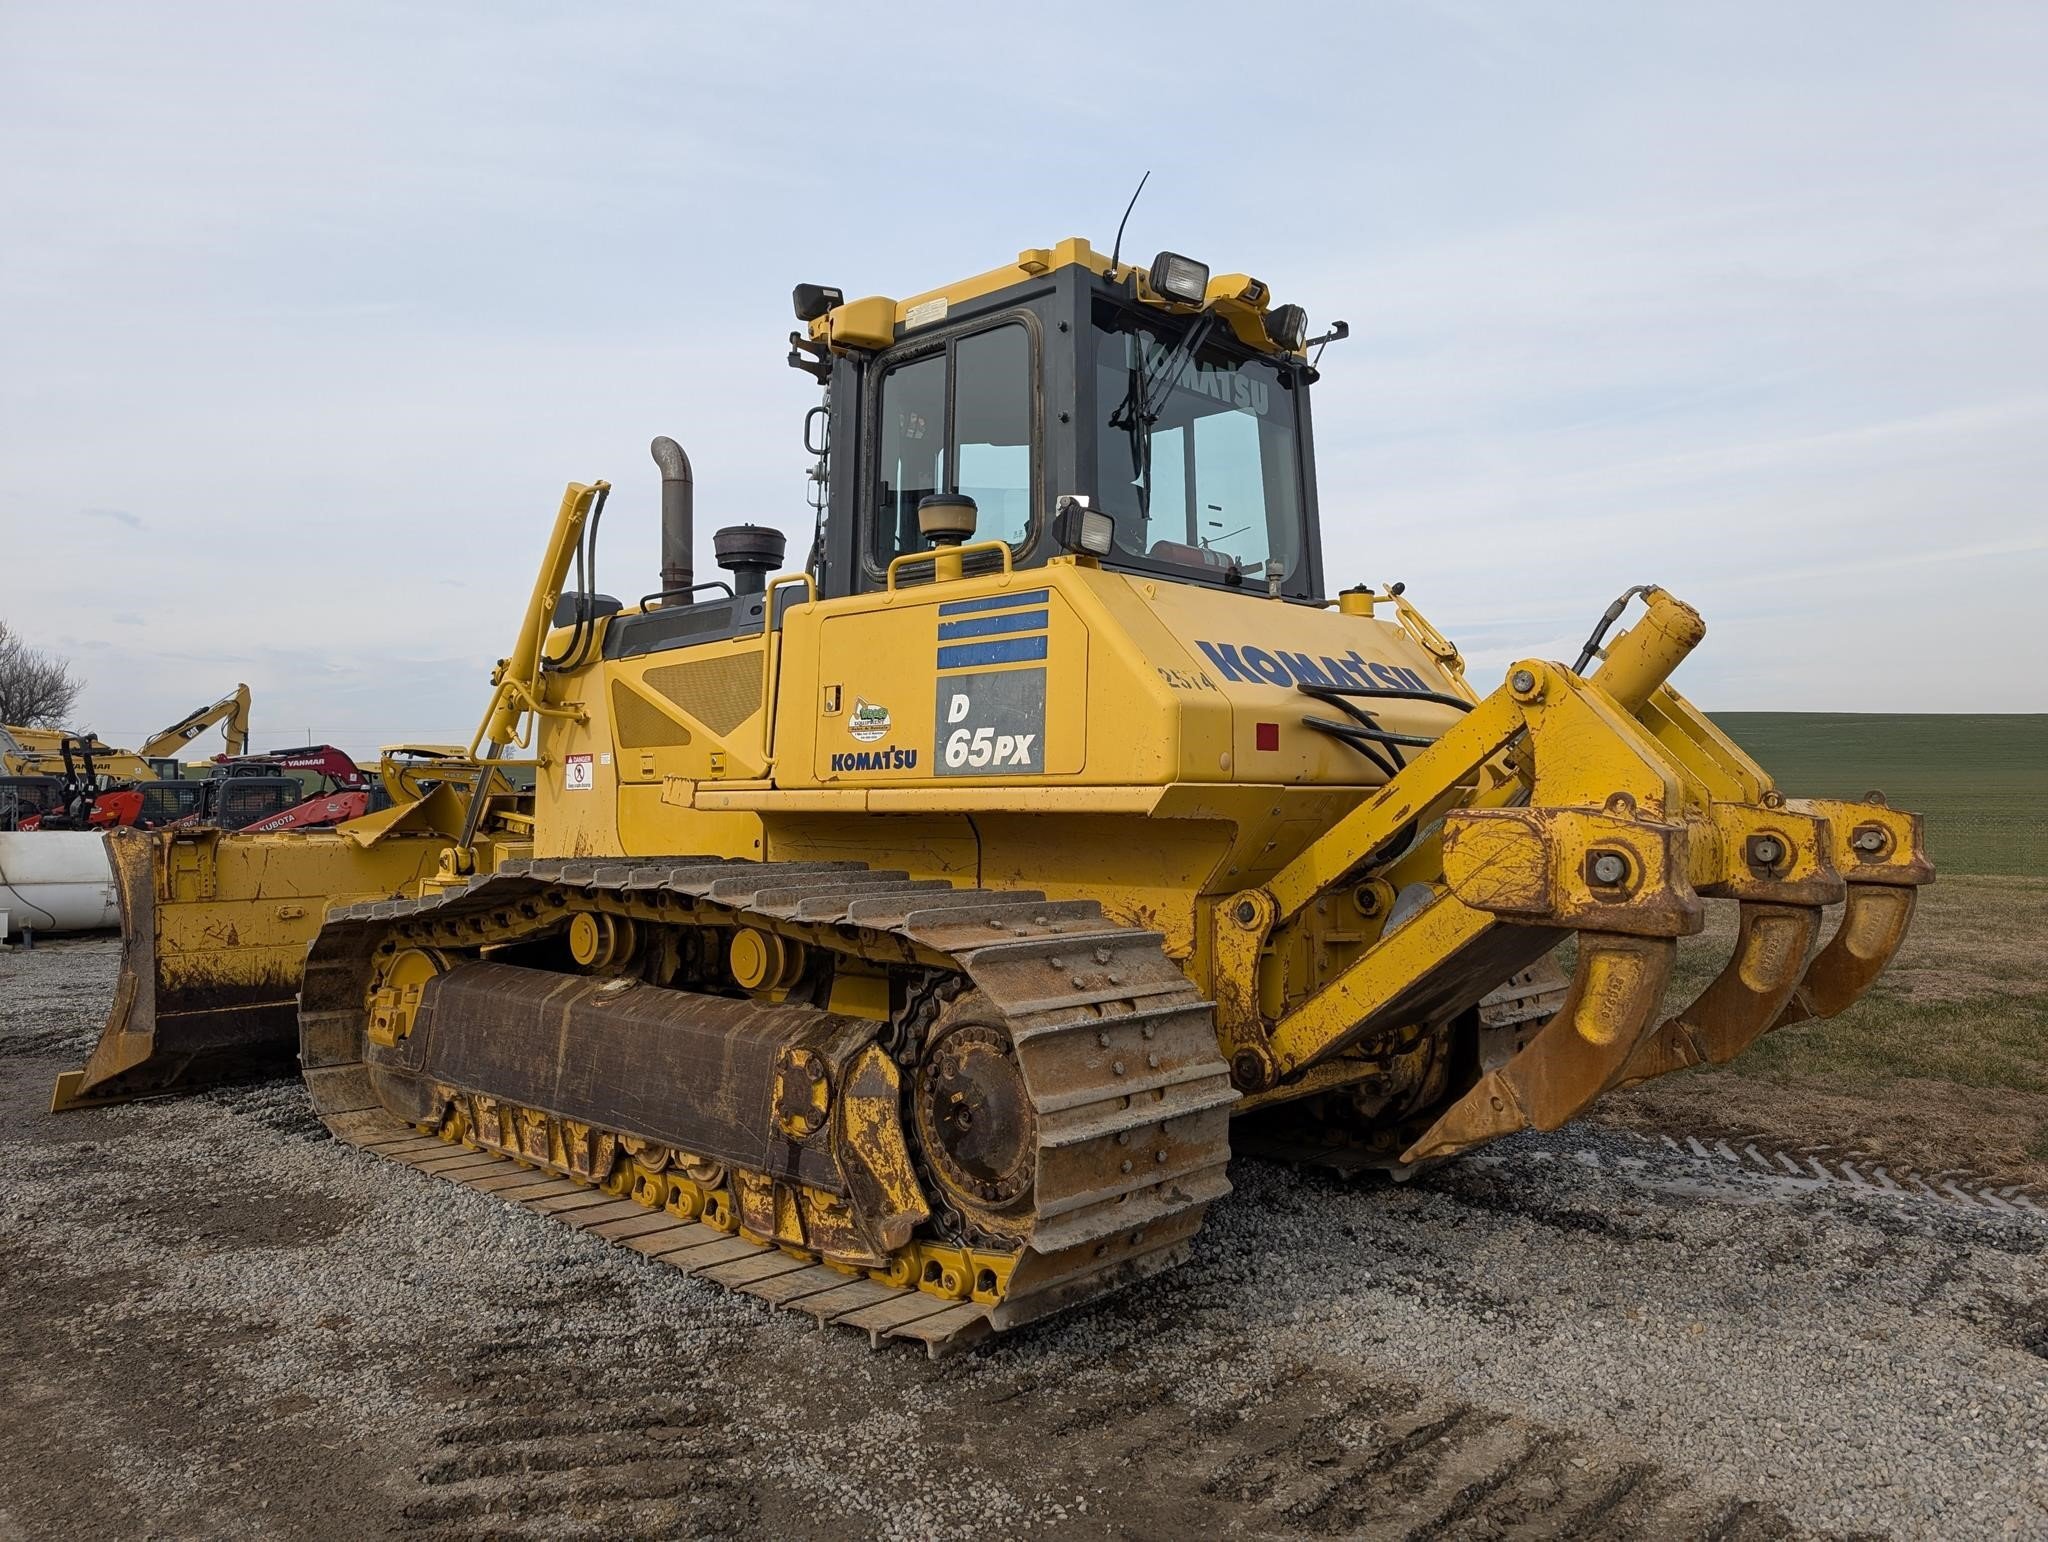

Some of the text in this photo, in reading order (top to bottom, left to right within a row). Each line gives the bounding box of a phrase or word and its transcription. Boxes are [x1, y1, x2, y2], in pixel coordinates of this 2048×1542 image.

[1125, 333, 1269, 415] KOMATSU
[1194, 640, 1432, 690] KOMATSU
[948, 694, 970, 723] D
[186, 726, 199, 738] CAT
[288, 759, 325, 767] YANMAR
[573, 755, 591, 763] DANGER
[831, 744, 917, 771] KOMATSU
[259, 814, 295, 832] KUBOTA
